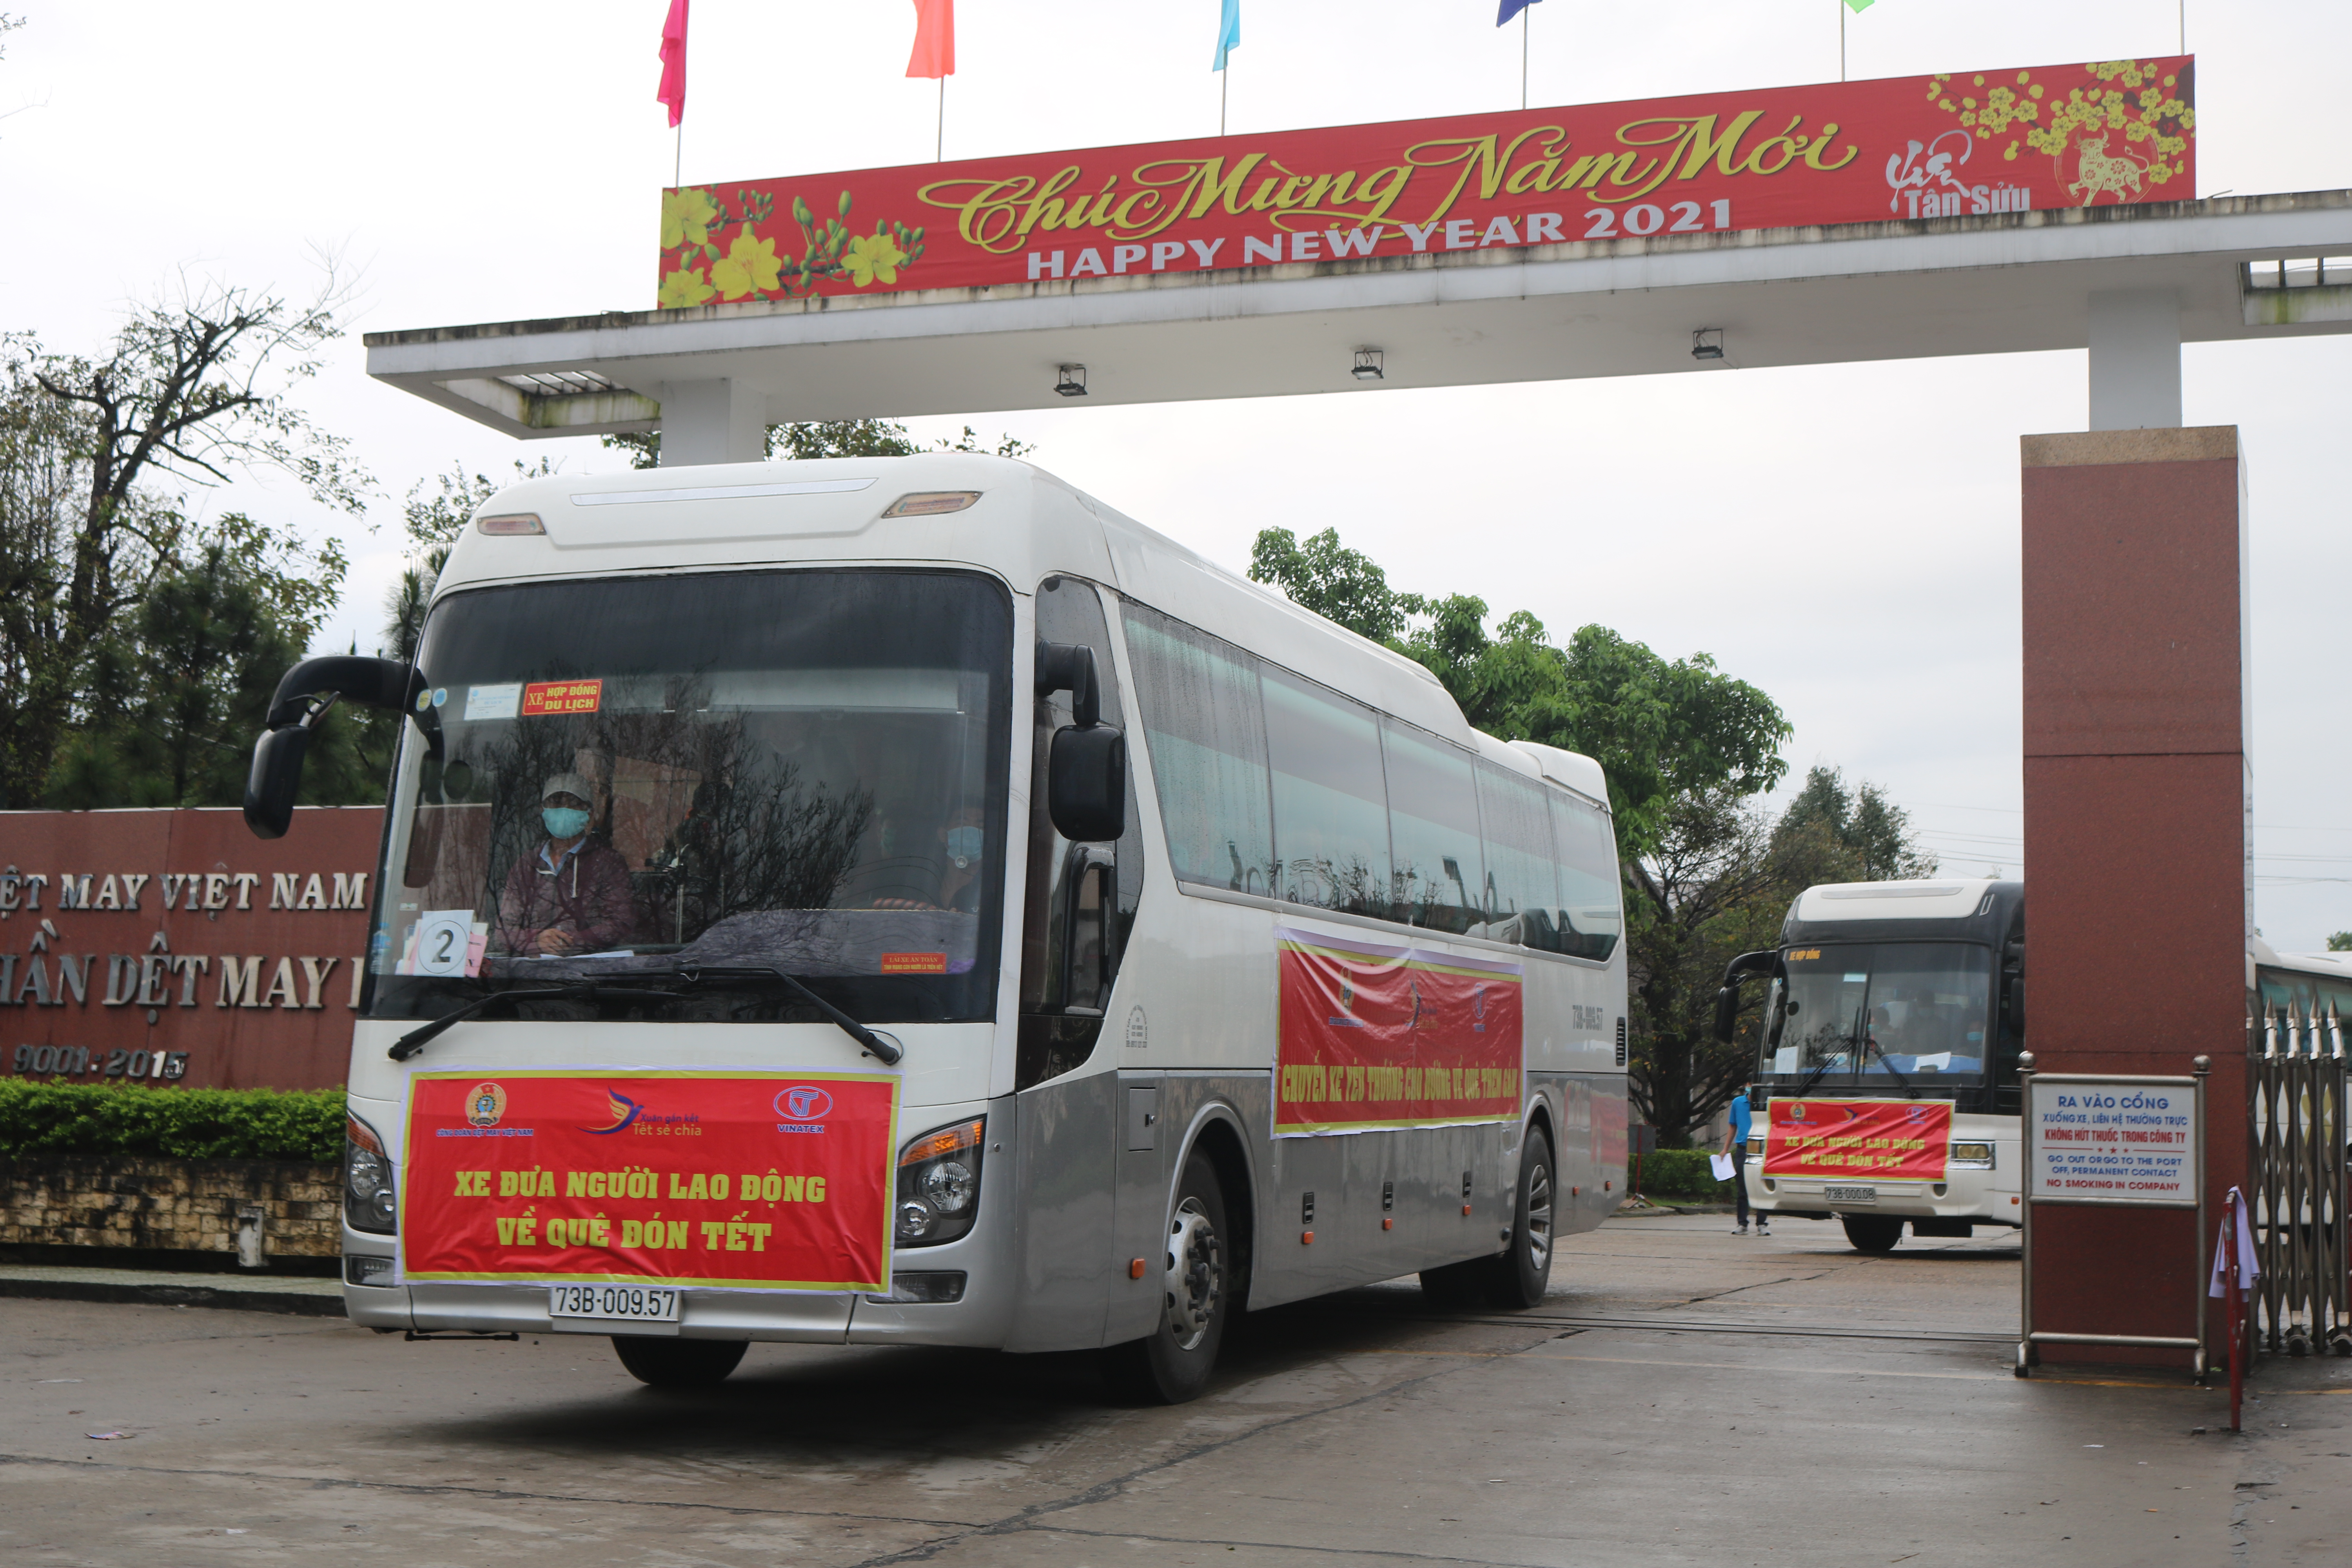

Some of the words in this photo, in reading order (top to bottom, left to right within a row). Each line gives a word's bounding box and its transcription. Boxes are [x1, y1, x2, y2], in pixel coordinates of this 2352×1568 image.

[916, 165, 1167, 254] Chúc
[1105, 152, 1520, 240] Mừng
[1330, 125, 1658, 240] Năm
[1586, 110, 1858, 204] Mới
[1904, 188, 1960, 219] Tân
[1971, 181, 2030, 214] Sửu
[1027, 237, 1225, 280] HAPPY
[1244, 226, 1384, 265] NEW
[1399, 212, 1567, 252] YEAR
[1583, 198, 1731, 238] 2021
[527, 692, 544, 706] XE
[546, 686, 568, 699] HỢP
[569, 683, 598, 696] ĐỒNG
[544, 700, 563, 710] DU
[565, 699, 595, 711] LỊCH
[58, 874, 149, 911] MAY
[159, 862, 261, 921] VIỆT
[269, 873, 368, 910] NAM
[432, 929, 454, 963] 2
[102, 931, 210, 1025] DỆT
[215, 955, 340, 1009] MAY
[13, 1044, 189, 1080] 9001:2015
[1282, 1050, 1327, 1103] CHUYẾN
[1329, 1065, 1344, 1102] XE
[2058, 1096, 2078, 1107] RA
[2083, 1093, 2116, 1108] VÀO
[2120, 1091, 2169, 1109] CỔNG
[640, 1113, 662, 1122] Xuân
[684, 1113, 699, 1122] kết
[2043, 1110, 2075, 1123] XUỐNG
[2076, 1115, 2090, 1125] XE,
[2092, 1113, 2110, 1124] LIÊN
[2112, 1113, 2123, 1127] HỆ
[2126, 1113, 2162, 1125] THƯỜNG
[2164, 1116, 2188, 1128] TRỰC
[632, 1122, 653, 1135] Tết
[656, 1124, 671, 1136] sẻ
[674, 1124, 702, 1136] chia
[777, 1124, 824, 1134] VINATEX
[2045, 1127, 2073, 1141] KHÔNG
[2074, 1127, 2090, 1142] HÚT
[2091, 1127, 2118, 1142] THUỐC
[2121, 1131, 2149, 1143] TRONG
[2150, 1129, 2173, 1143] CÔNG
[2176, 1132, 2186, 1143] TY
[1785, 1136, 1800, 1147] XE
[1803, 1135, 1825, 1147] ĐƯA
[1828, 1136, 1862, 1148] NGƯỜI
[1866, 1138, 1889, 1149] LAO
[1893, 1137, 1926, 1152] ĐỘNG
[1801, 1151, 1817, 1165] VỀ
[1819, 1152, 1844, 1167] QUÊ
[1847, 1152, 1874, 1167] ĐÓN
[1877, 1152, 1904, 1168] TẾT
[2047, 1154, 2063, 1163] GO
[2068, 1155, 2085, 1163] OUT
[2089, 1156, 2103, 1164] OR
[2103, 1156, 2118, 1164] GO
[2137, 1157, 2154, 1165] THE
[2156, 1158, 2182, 1167] PORT
[2052, 1166, 2070, 1176] OFF,
[2072, 1167, 2129, 1176] PERMANENT
[2131, 1168, 2178, 1178] CONTACT
[454, 1171, 492, 1196] XE
[499, 1165, 556, 1197] ĐƯA
[566, 1165, 659, 1199] NGƯỜI
[669, 1173, 730, 1200] LAO
[740, 1168, 826, 1209] ĐỘNG
[2046, 1179, 2062, 1188] NO
[2065, 1180, 2113, 1189] SMOKING
[2116, 1181, 2125, 1190] IN
[2129, 1181, 2181, 1191] COMPANY
[496, 1205, 537, 1246] VỀ
[546, 1212, 611, 1250] QUÊ
[621, 1212, 689, 1250] ĐÓN
[701, 1211, 772, 1252] TẾT
[556, 1287, 675, 1317] 73B-009.57
